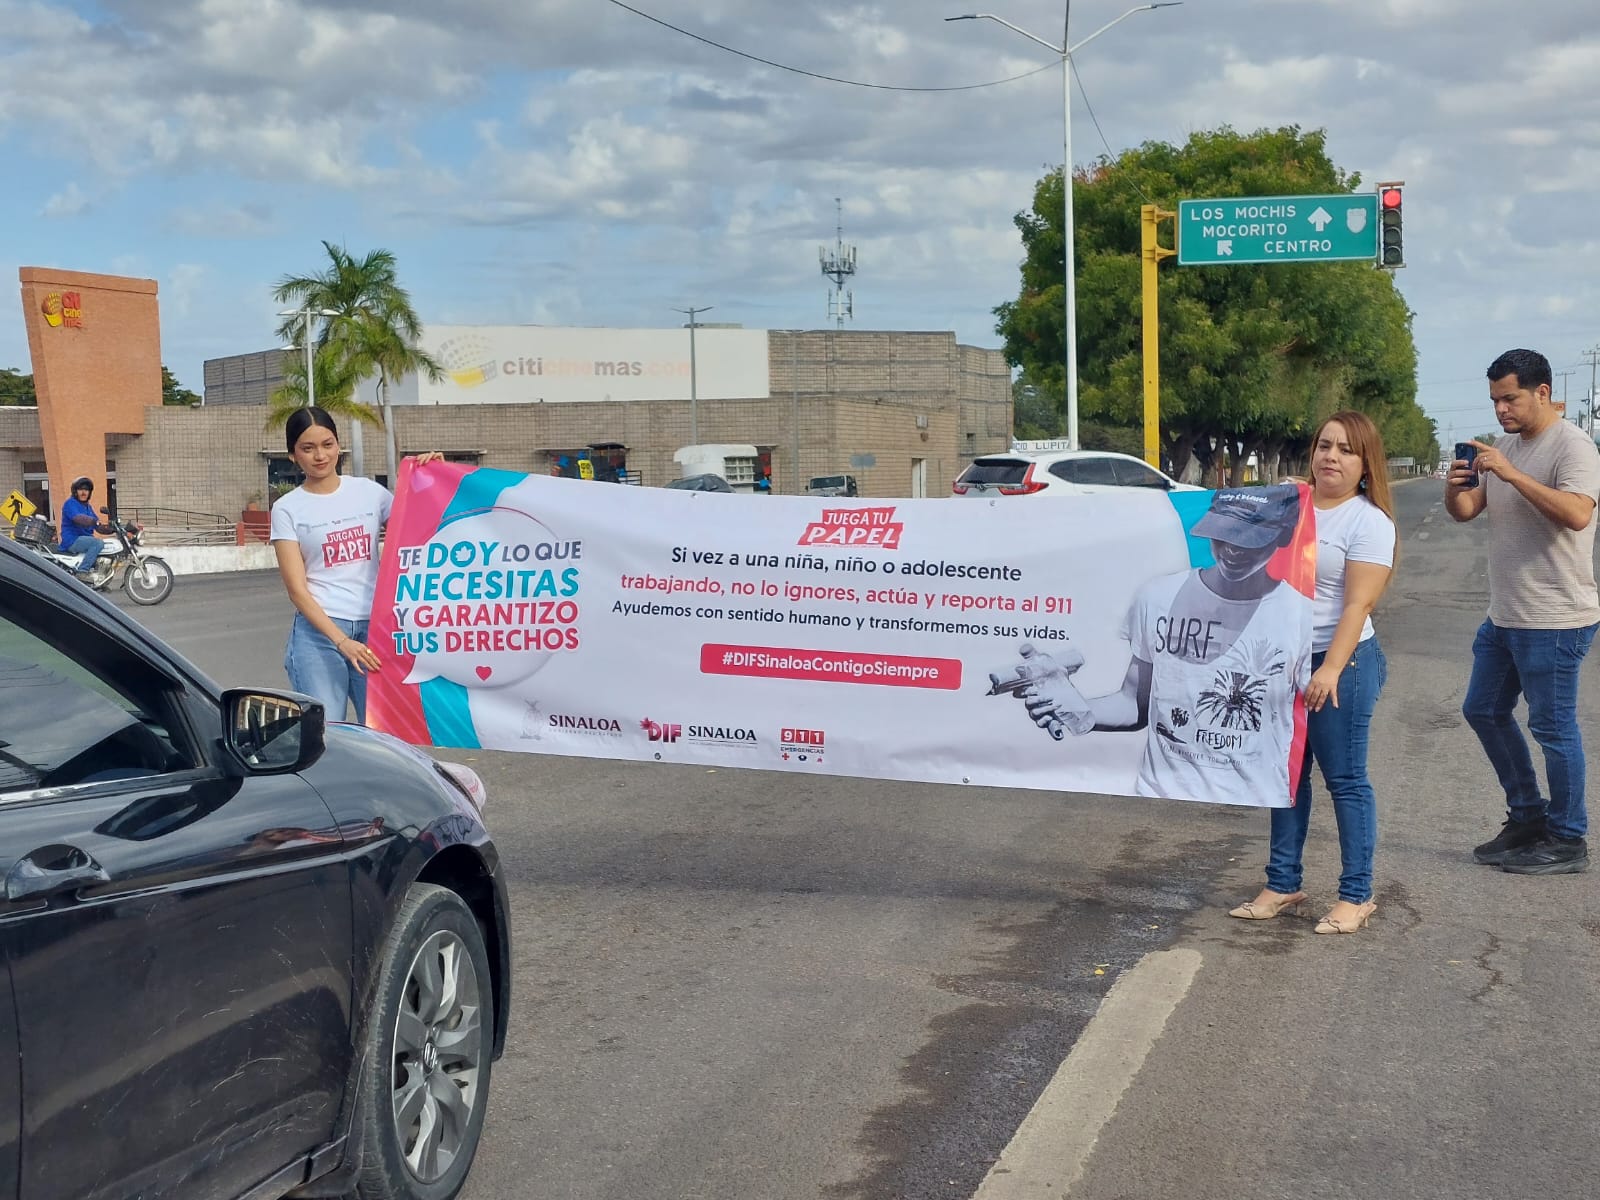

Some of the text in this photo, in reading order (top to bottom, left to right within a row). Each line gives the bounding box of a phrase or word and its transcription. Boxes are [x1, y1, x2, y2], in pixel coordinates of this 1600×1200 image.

[1191, 205, 1296, 221] LOS MOCHIS
[1203, 223, 1288, 238] MOCORITO
[1264, 240, 1332, 254] CENTRO
[824, 511, 889, 525] JUEGA TU
[328, 527, 364, 543] JUEGA TU
[807, 527, 896, 544] PAPEL
[400, 541, 581, 568] TE DOY LO QUE
[672, 547, 1022, 581] Si vez a una niña, niño o adolescente
[396, 568, 579, 601] NECESITAS
[620, 573, 1072, 614] trabajando, no lo ignores, actúa y reporta al 911
[396, 601, 578, 628] Y GARANTIZO
[612, 600, 1070, 641] Ayudemos con sentido humano y transformemos sus vidas.
[393, 628, 579, 653] TUS DERECHOS
[1155, 615, 1222, 660] SURF
[722, 651, 939, 680] #DIFSinaloaContigoSiempre
[549, 714, 621, 732] SINALOA
[647, 720, 757, 743] DIF SINALOA
[783, 730, 821, 743] 911
[1195, 729, 1242, 751] FREEDOM
